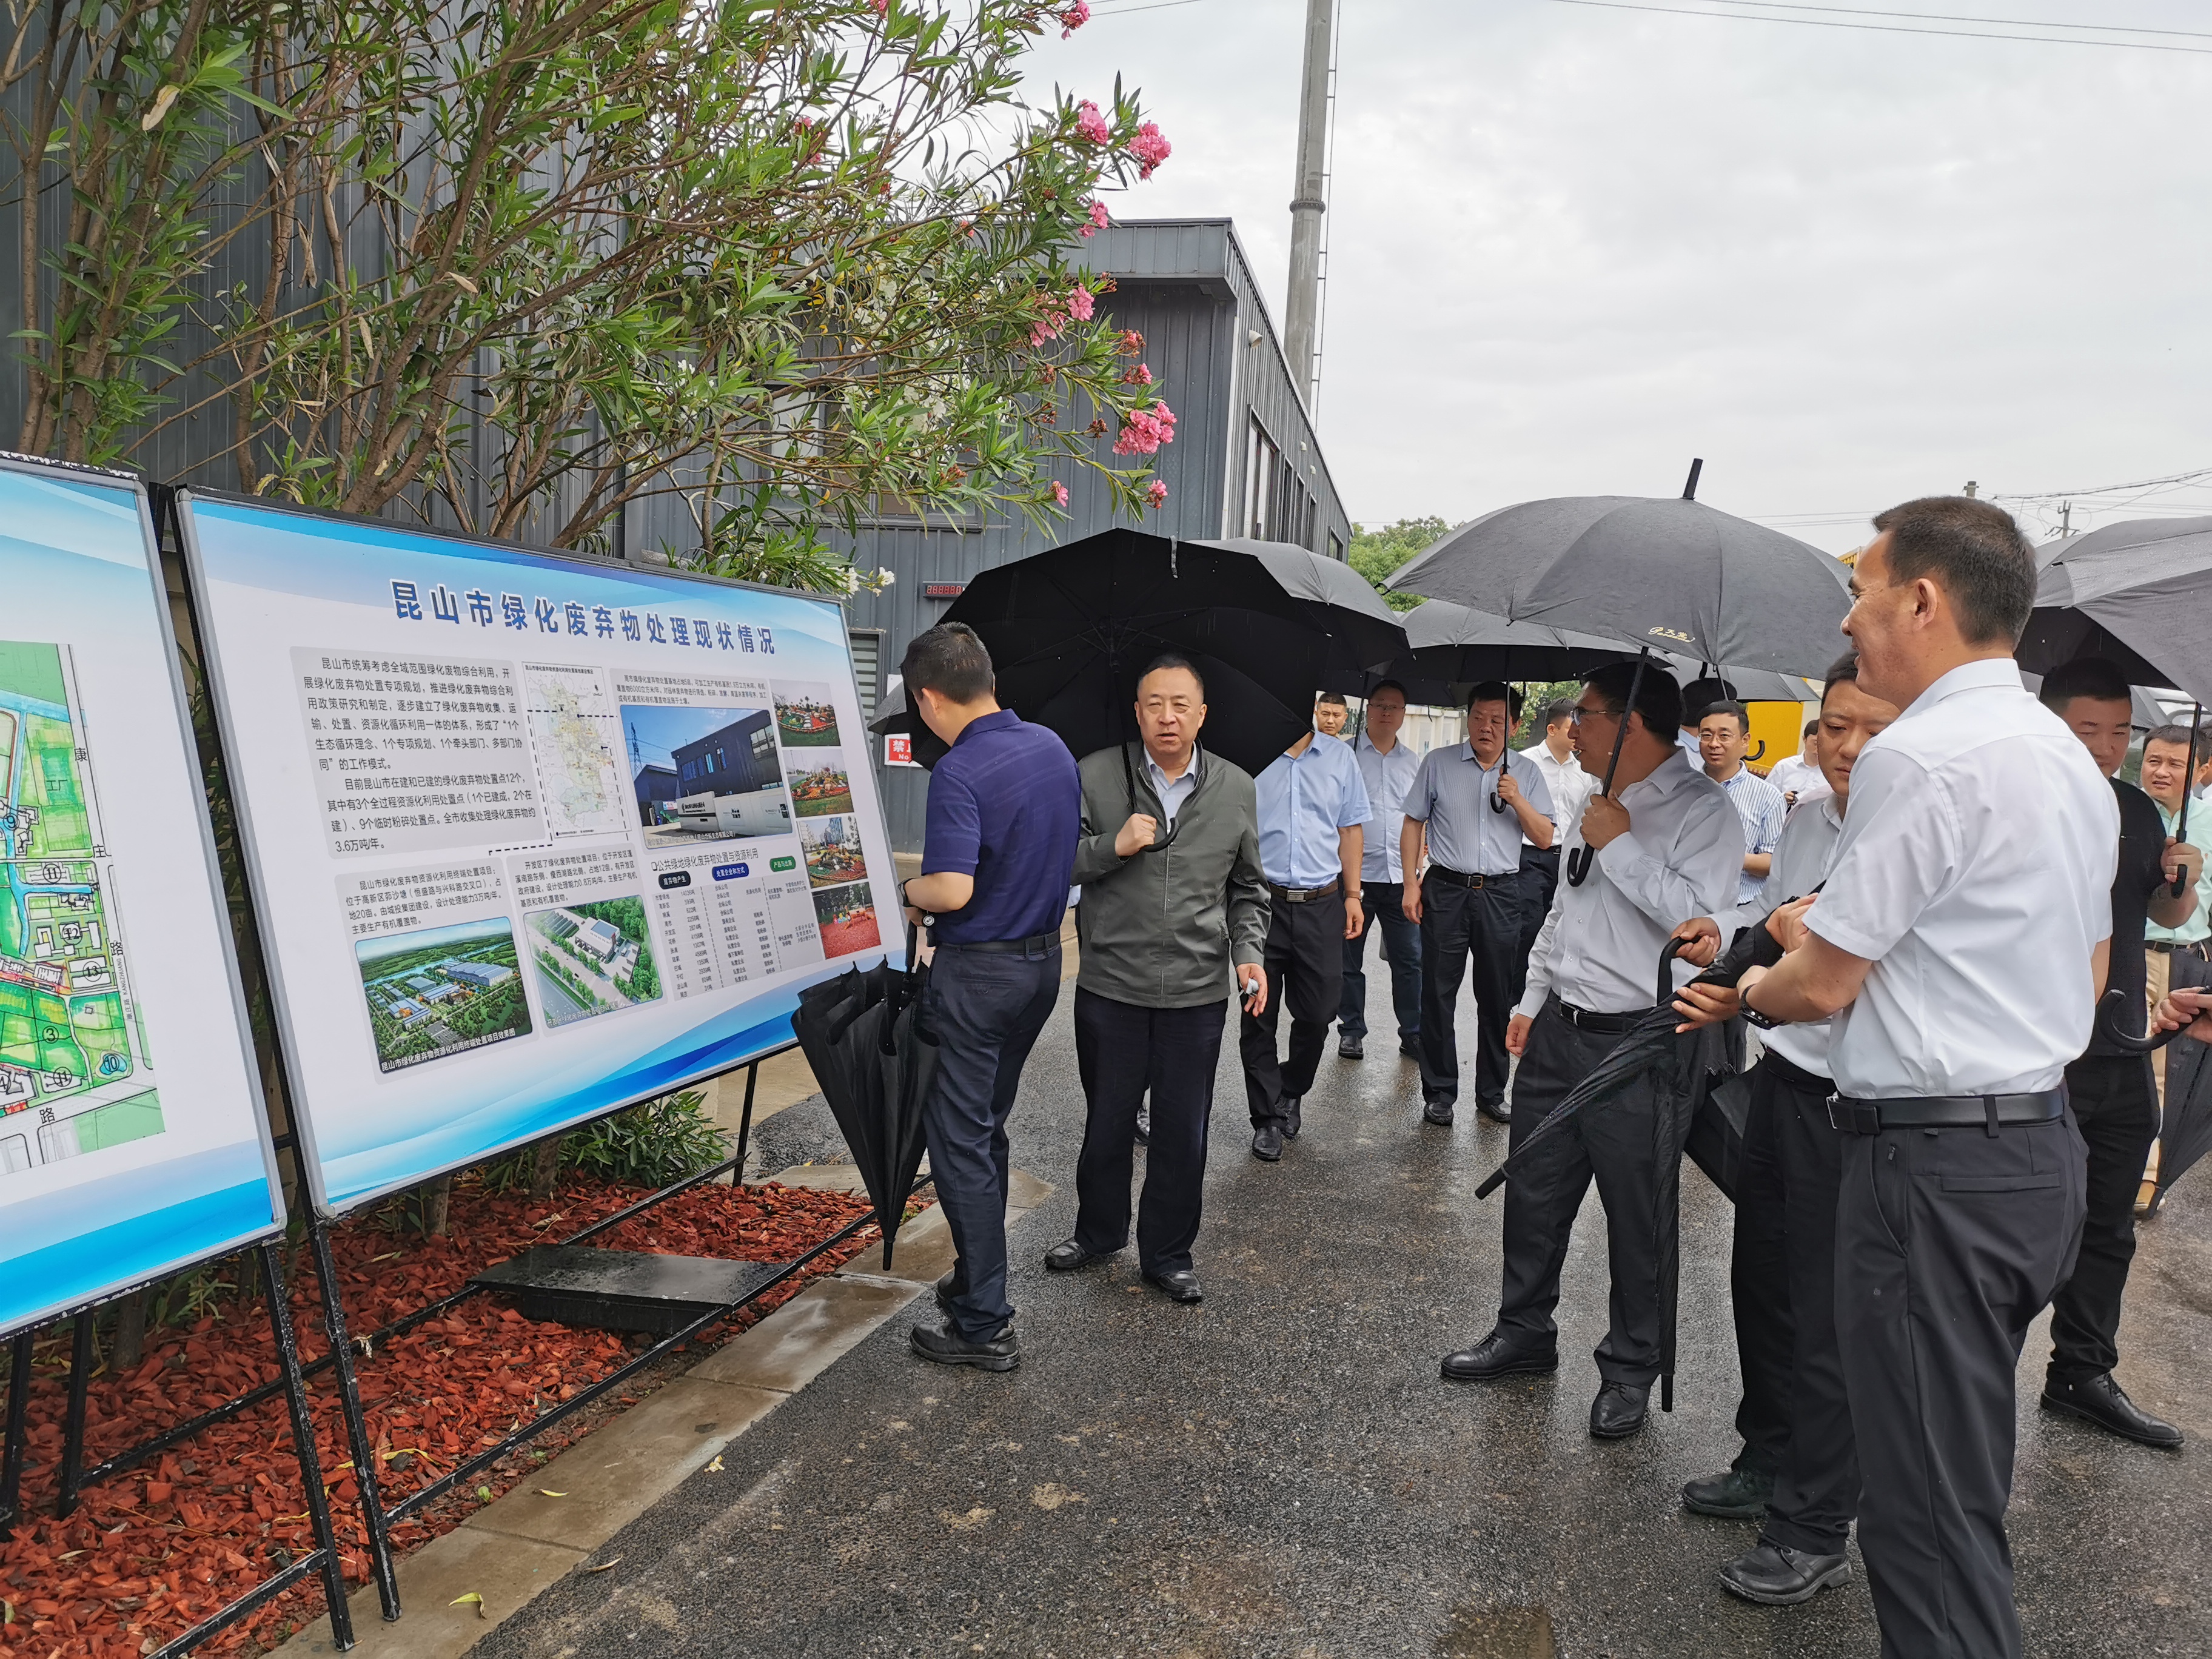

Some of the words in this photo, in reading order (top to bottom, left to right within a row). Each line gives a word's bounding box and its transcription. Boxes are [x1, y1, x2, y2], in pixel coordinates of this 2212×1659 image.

[390, 579, 776, 654] 昆山市绿化废弃物处理现状情况
[74, 748, 87, 762] 康
[46, 779, 68, 791] 工厂
[92, 844, 106, 858] 庄
[47, 868, 57, 879] 11
[352, 916, 421, 934] 主要生产有机覆盖物。
[67, 929, 79, 940] 12
[110, 940, 123, 956] 路
[86, 967, 98, 977] 13
[117, 958, 127, 995] KANGZHUANG
[46, 1029, 56, 1042] 3
[107, 1056, 118, 1069] 10
[39, 1107, 55, 1124] 路
